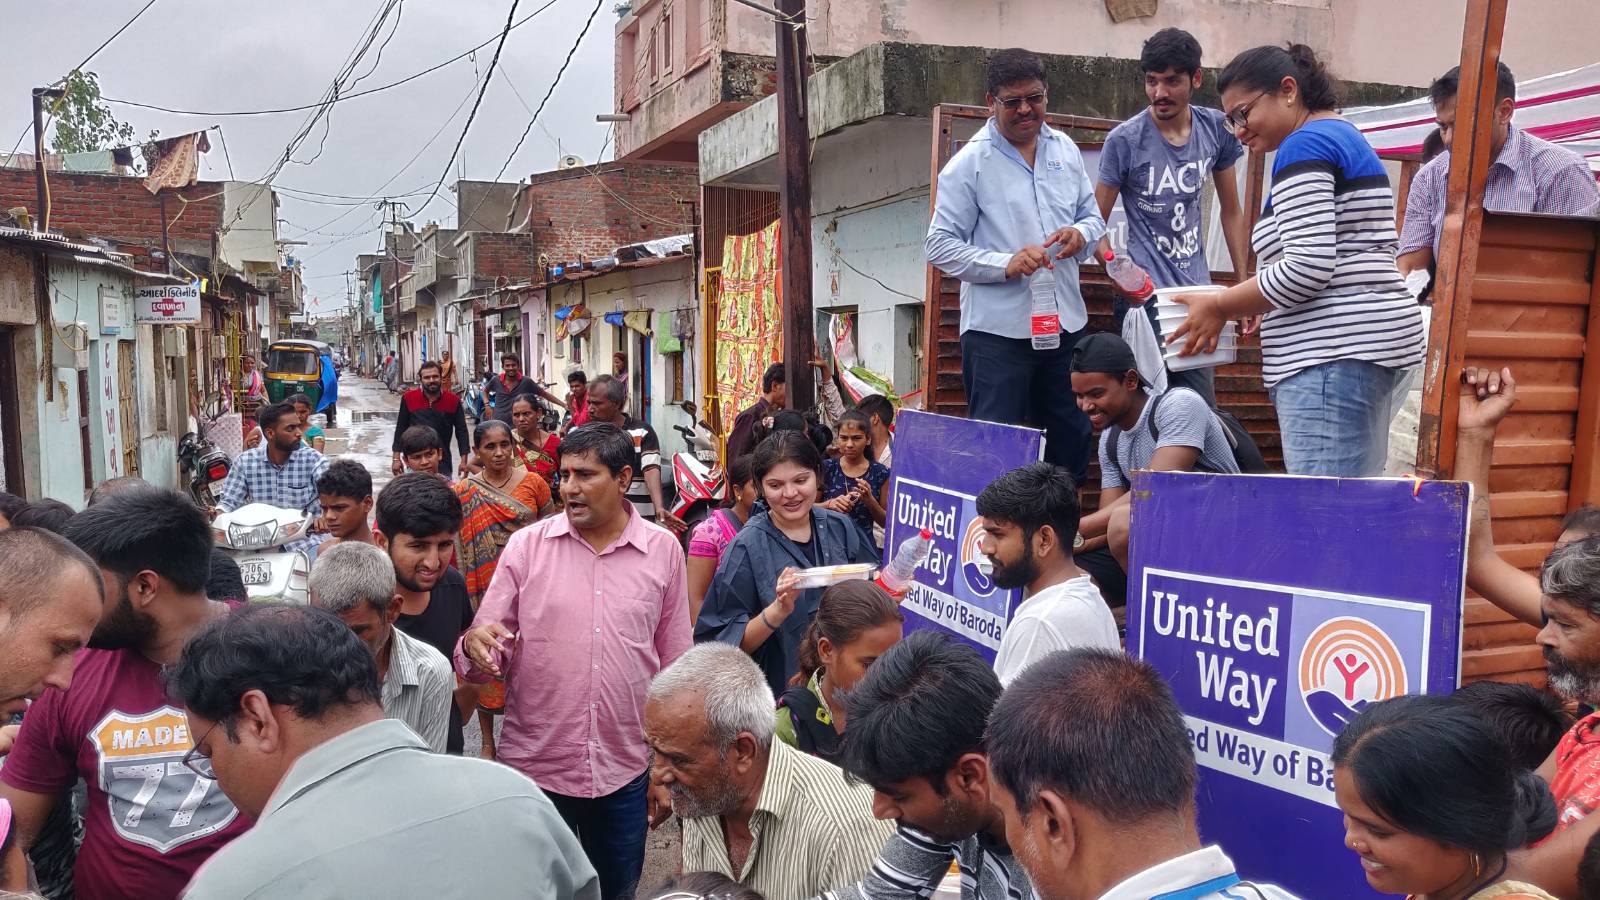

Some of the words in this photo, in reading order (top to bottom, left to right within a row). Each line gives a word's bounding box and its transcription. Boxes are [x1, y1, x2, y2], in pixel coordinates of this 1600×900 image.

[1142, 157, 1211, 196] JACK
[1138, 202, 1163, 213] CLOTHING
[1171, 202, 1186, 232] &
[1156, 226, 1199, 259] ONES
[898, 492, 957, 541] United
[922, 590, 944, 617] Way
[946, 602, 960, 621] of
[960, 605, 1002, 641] Baroda
[1152, 590, 1280, 657] United
[1196, 651, 1277, 726] Way
[112, 724, 188, 750] MADE
[1215, 730, 1266, 775] Way
[1273, 751, 1300, 779] of
[112, 762, 212, 828] 77
